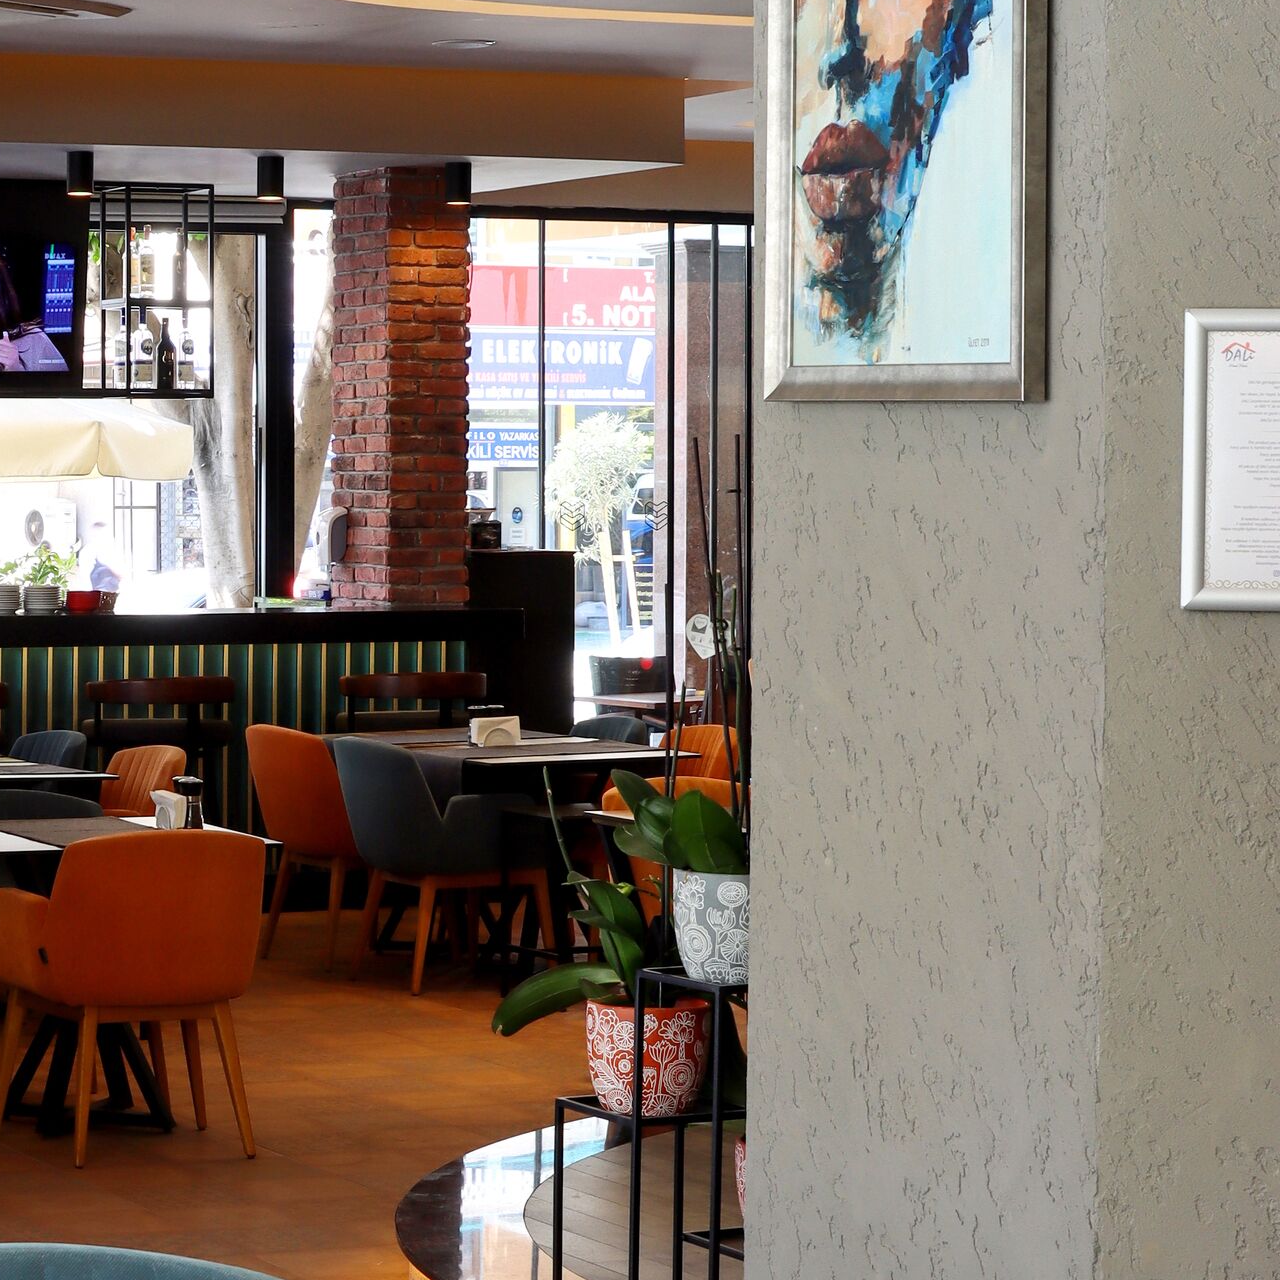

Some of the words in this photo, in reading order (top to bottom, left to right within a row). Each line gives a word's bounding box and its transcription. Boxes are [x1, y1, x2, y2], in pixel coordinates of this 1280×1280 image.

[620, 286, 655, 301] ALA
[572, 304, 595, 326] 5.
[602, 305, 655, 326] NOT
[475, 372, 496, 382] KASA
[520, 372, 529, 382] VE
